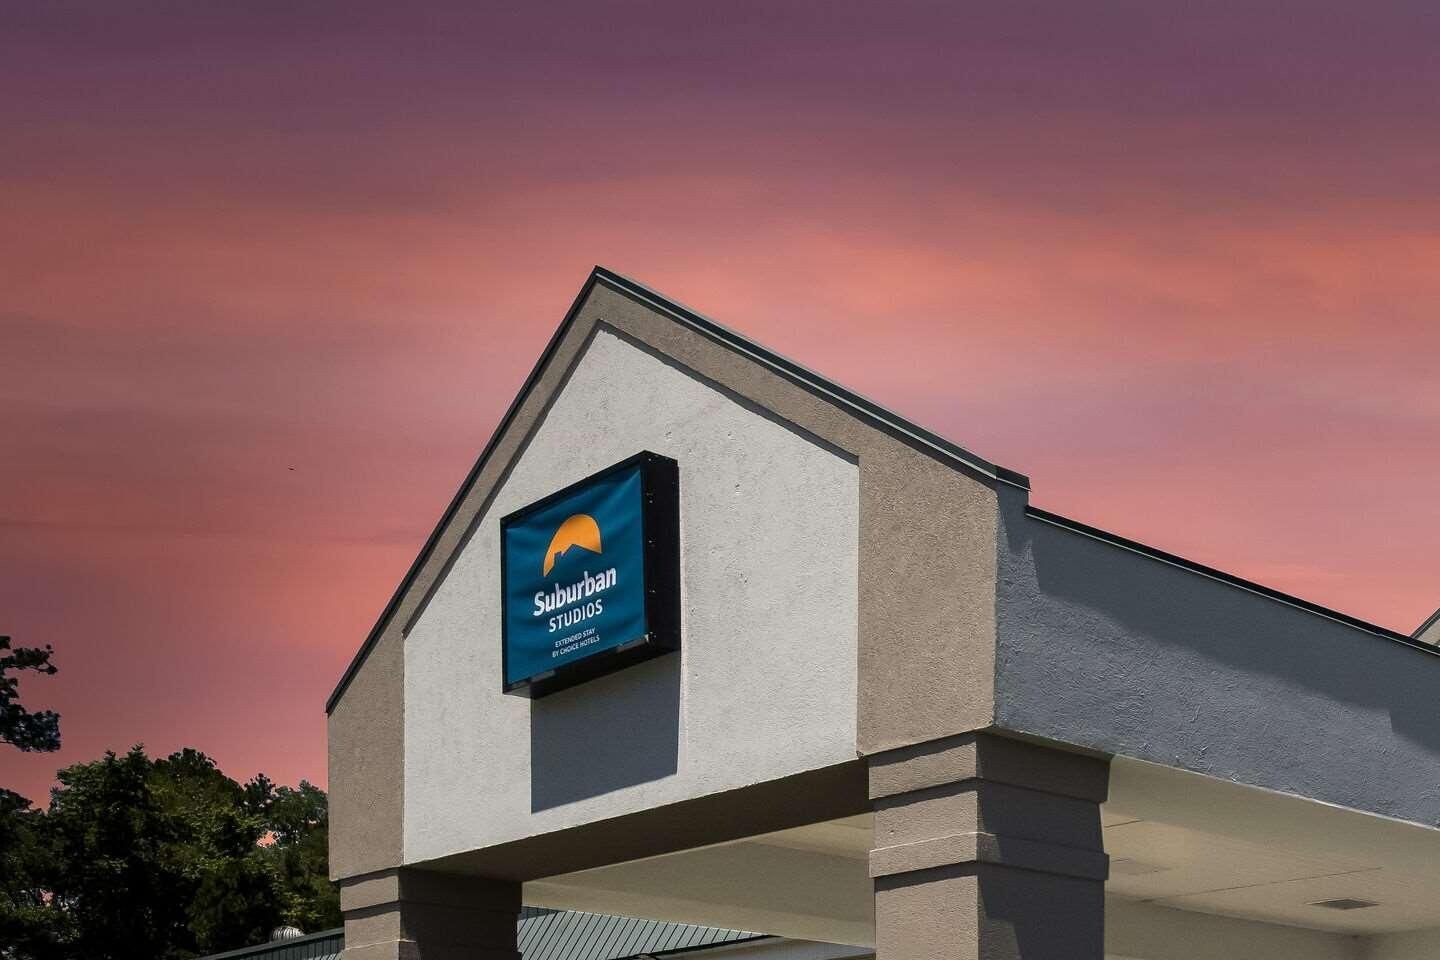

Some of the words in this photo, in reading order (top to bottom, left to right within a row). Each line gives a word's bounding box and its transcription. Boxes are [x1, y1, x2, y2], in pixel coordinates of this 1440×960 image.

[533, 567, 617, 616] Suburban
[548, 599, 603, 633] STUDIOS
[552, 650, 559, 658] BY
[560, 642, 579, 655] CHOICE
[579, 634, 600, 647] HOTELS
[555, 632, 582, 648] EXTENDED
[582, 627, 596, 637] STAY
